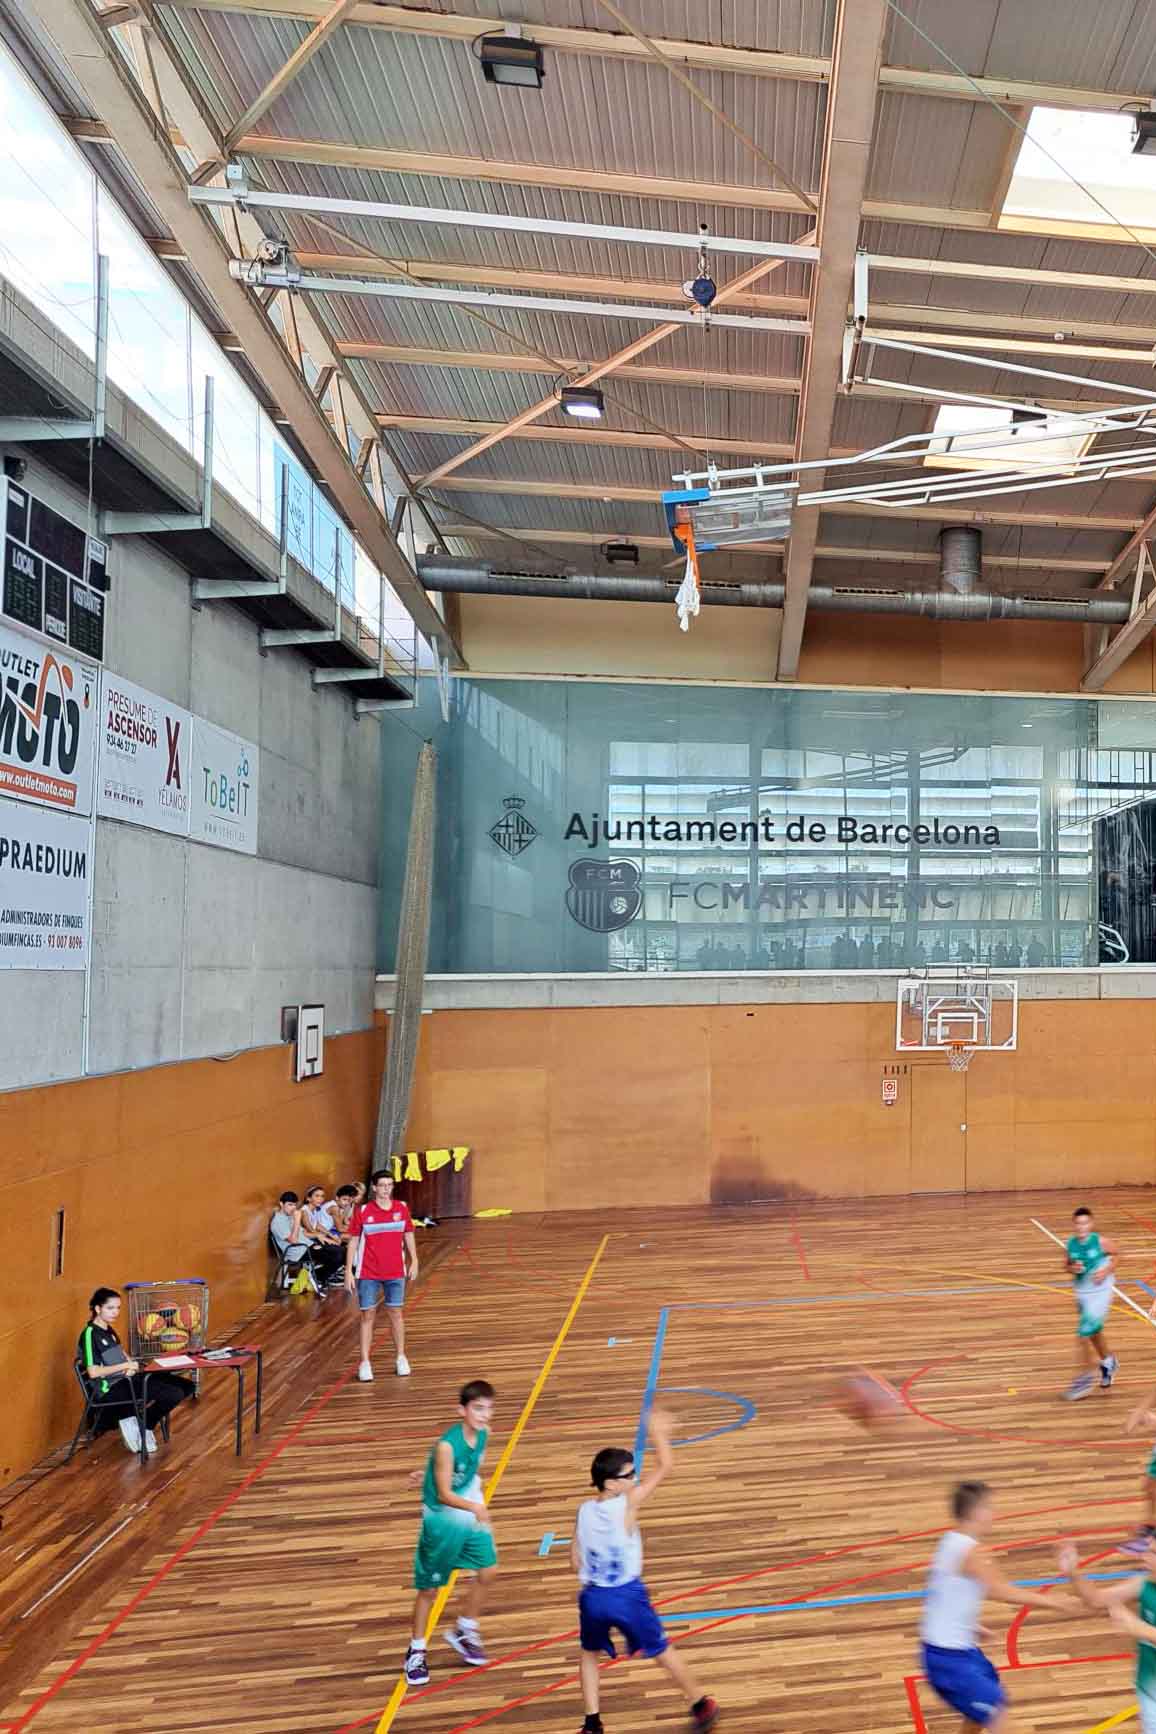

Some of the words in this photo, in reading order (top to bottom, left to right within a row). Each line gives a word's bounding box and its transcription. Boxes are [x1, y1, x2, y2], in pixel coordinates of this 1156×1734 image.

[12, 548, 36, 579] LOCAL
[0, 648, 40, 680] UTLET
[108, 689, 146, 723] PRESUME
[147, 707, 159, 727] DE
[107, 710, 157, 748] ASCENSOR
[203, 767, 250, 816] ToBeIT
[564, 812, 775, 848] Ajuntament
[786, 815, 827, 843] de
[837, 817, 1001, 845] Barcelona
[0, 837, 86, 879] PRAEDIUM
[586, 868, 622, 881] FCM
[1, 909, 53, 927] ADMINISTRADORS
[54, 913, 61, 928] DE
[62, 914, 83, 929] FINQUES
[0, 932, 42, 948] IUMFINCAS.ES
